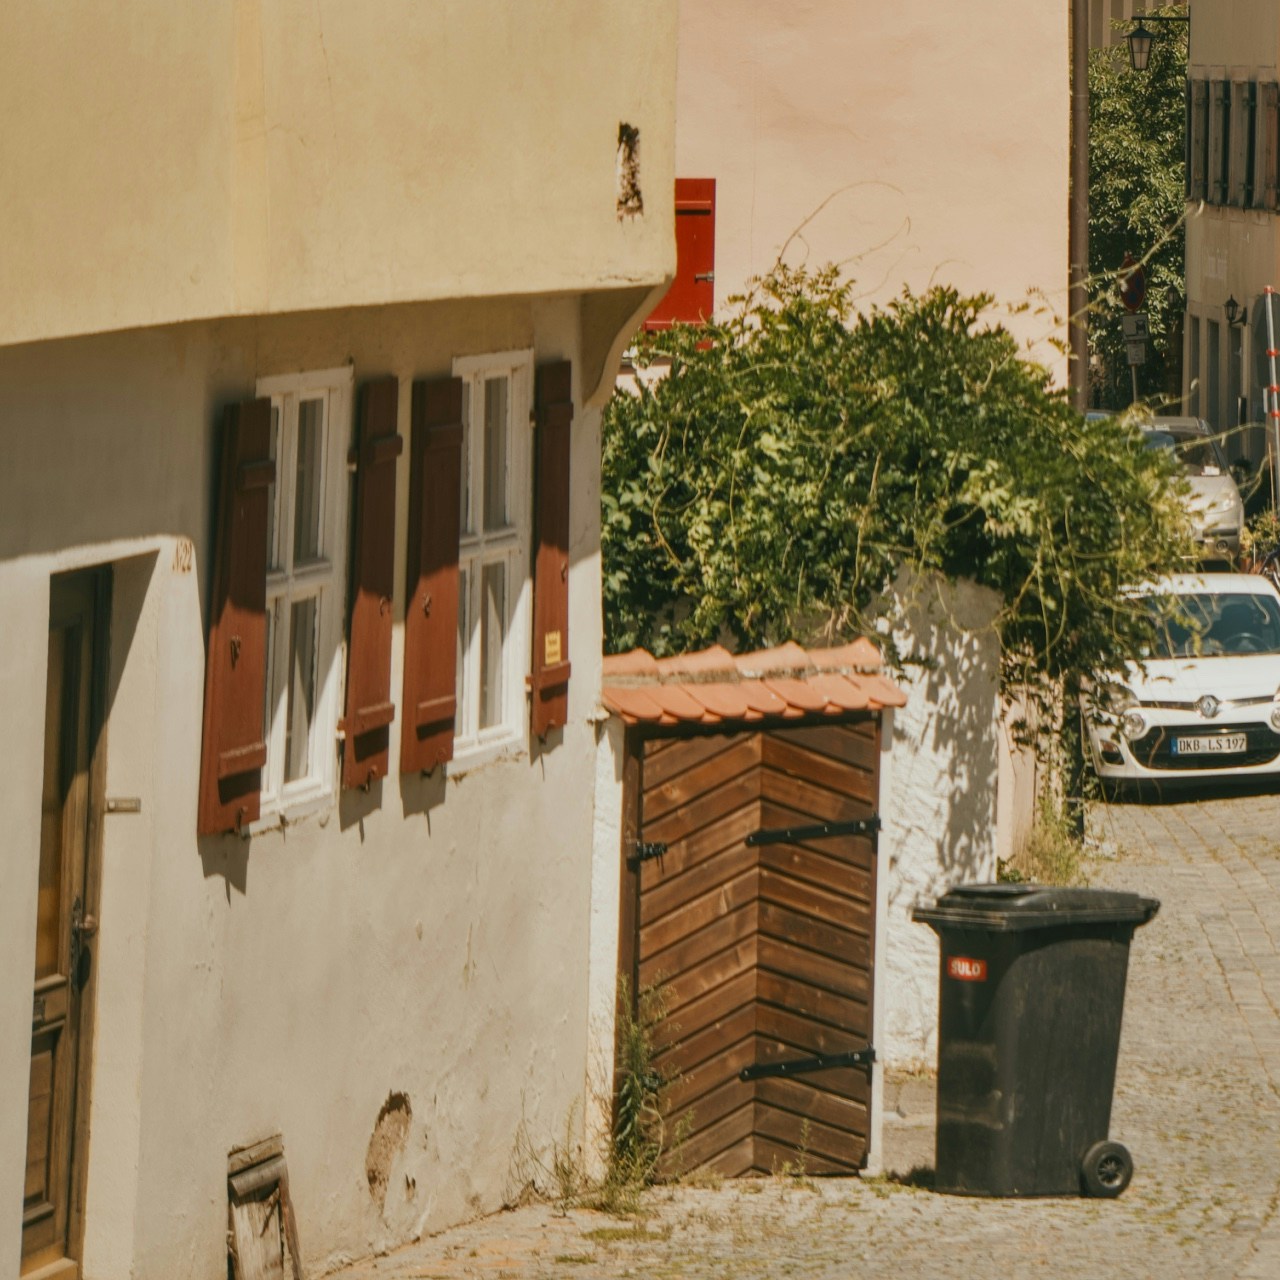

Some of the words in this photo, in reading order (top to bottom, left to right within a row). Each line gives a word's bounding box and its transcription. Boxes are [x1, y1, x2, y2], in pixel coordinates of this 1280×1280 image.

[1208, 738, 1222, 751] LS
[1226, 737, 1246, 750] 197
[951, 958, 981, 977] SULO
